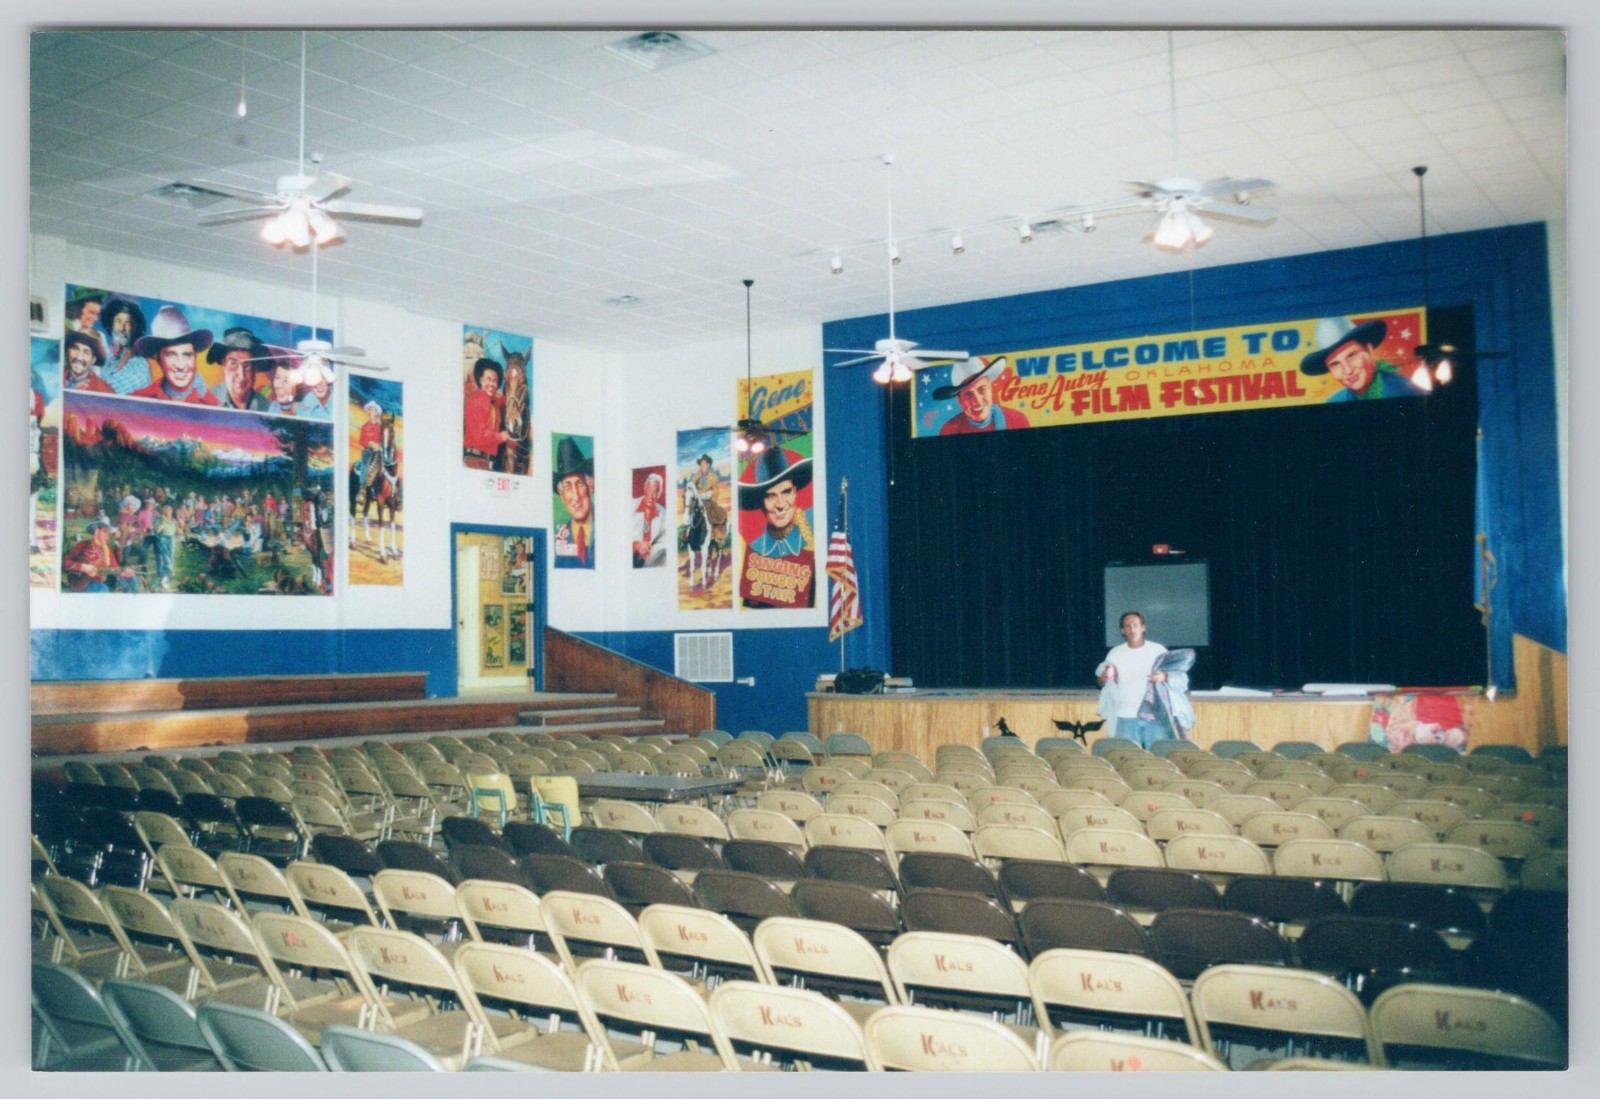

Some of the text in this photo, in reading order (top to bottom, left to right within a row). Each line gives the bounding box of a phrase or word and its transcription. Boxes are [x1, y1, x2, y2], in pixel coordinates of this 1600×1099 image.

[1015, 329, 1300, 377] WELCOME TO
[1125, 357, 1275, 381] OKLAHOMA
[750, 379, 806, 420] Gene
[1001, 370, 1108, 411] Gene Autry
[1071, 370, 1306, 416] FILM FESTIVAL
[746, 567, 809, 592] COWBOY
[748, 553, 811, 578] SINGING
[750, 581, 796, 603] STAR
